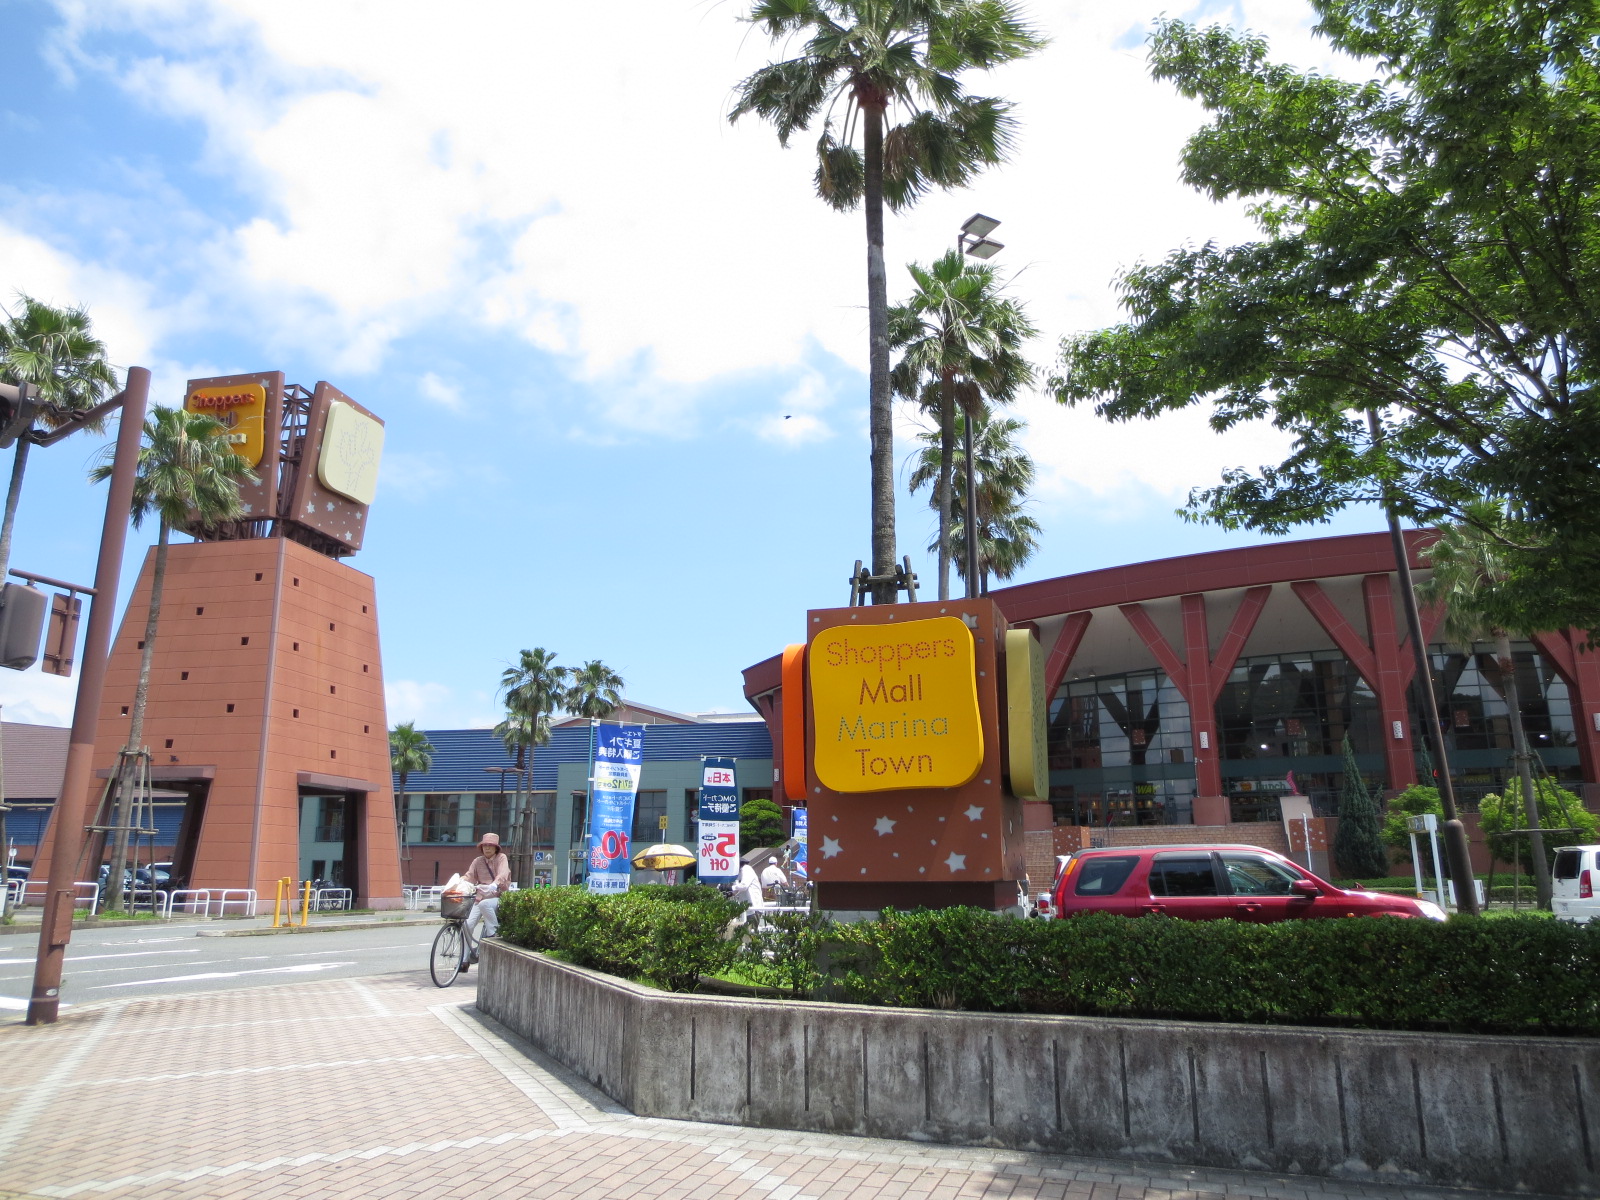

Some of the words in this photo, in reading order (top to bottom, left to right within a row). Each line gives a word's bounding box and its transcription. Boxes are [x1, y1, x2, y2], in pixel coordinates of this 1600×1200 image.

[192, 392, 255, 411] Shoppers
[827, 638, 956, 672] Shoppers
[859, 674, 922, 705] Mall
[838, 712, 948, 742] Marina
[855, 748, 933, 776] Town
